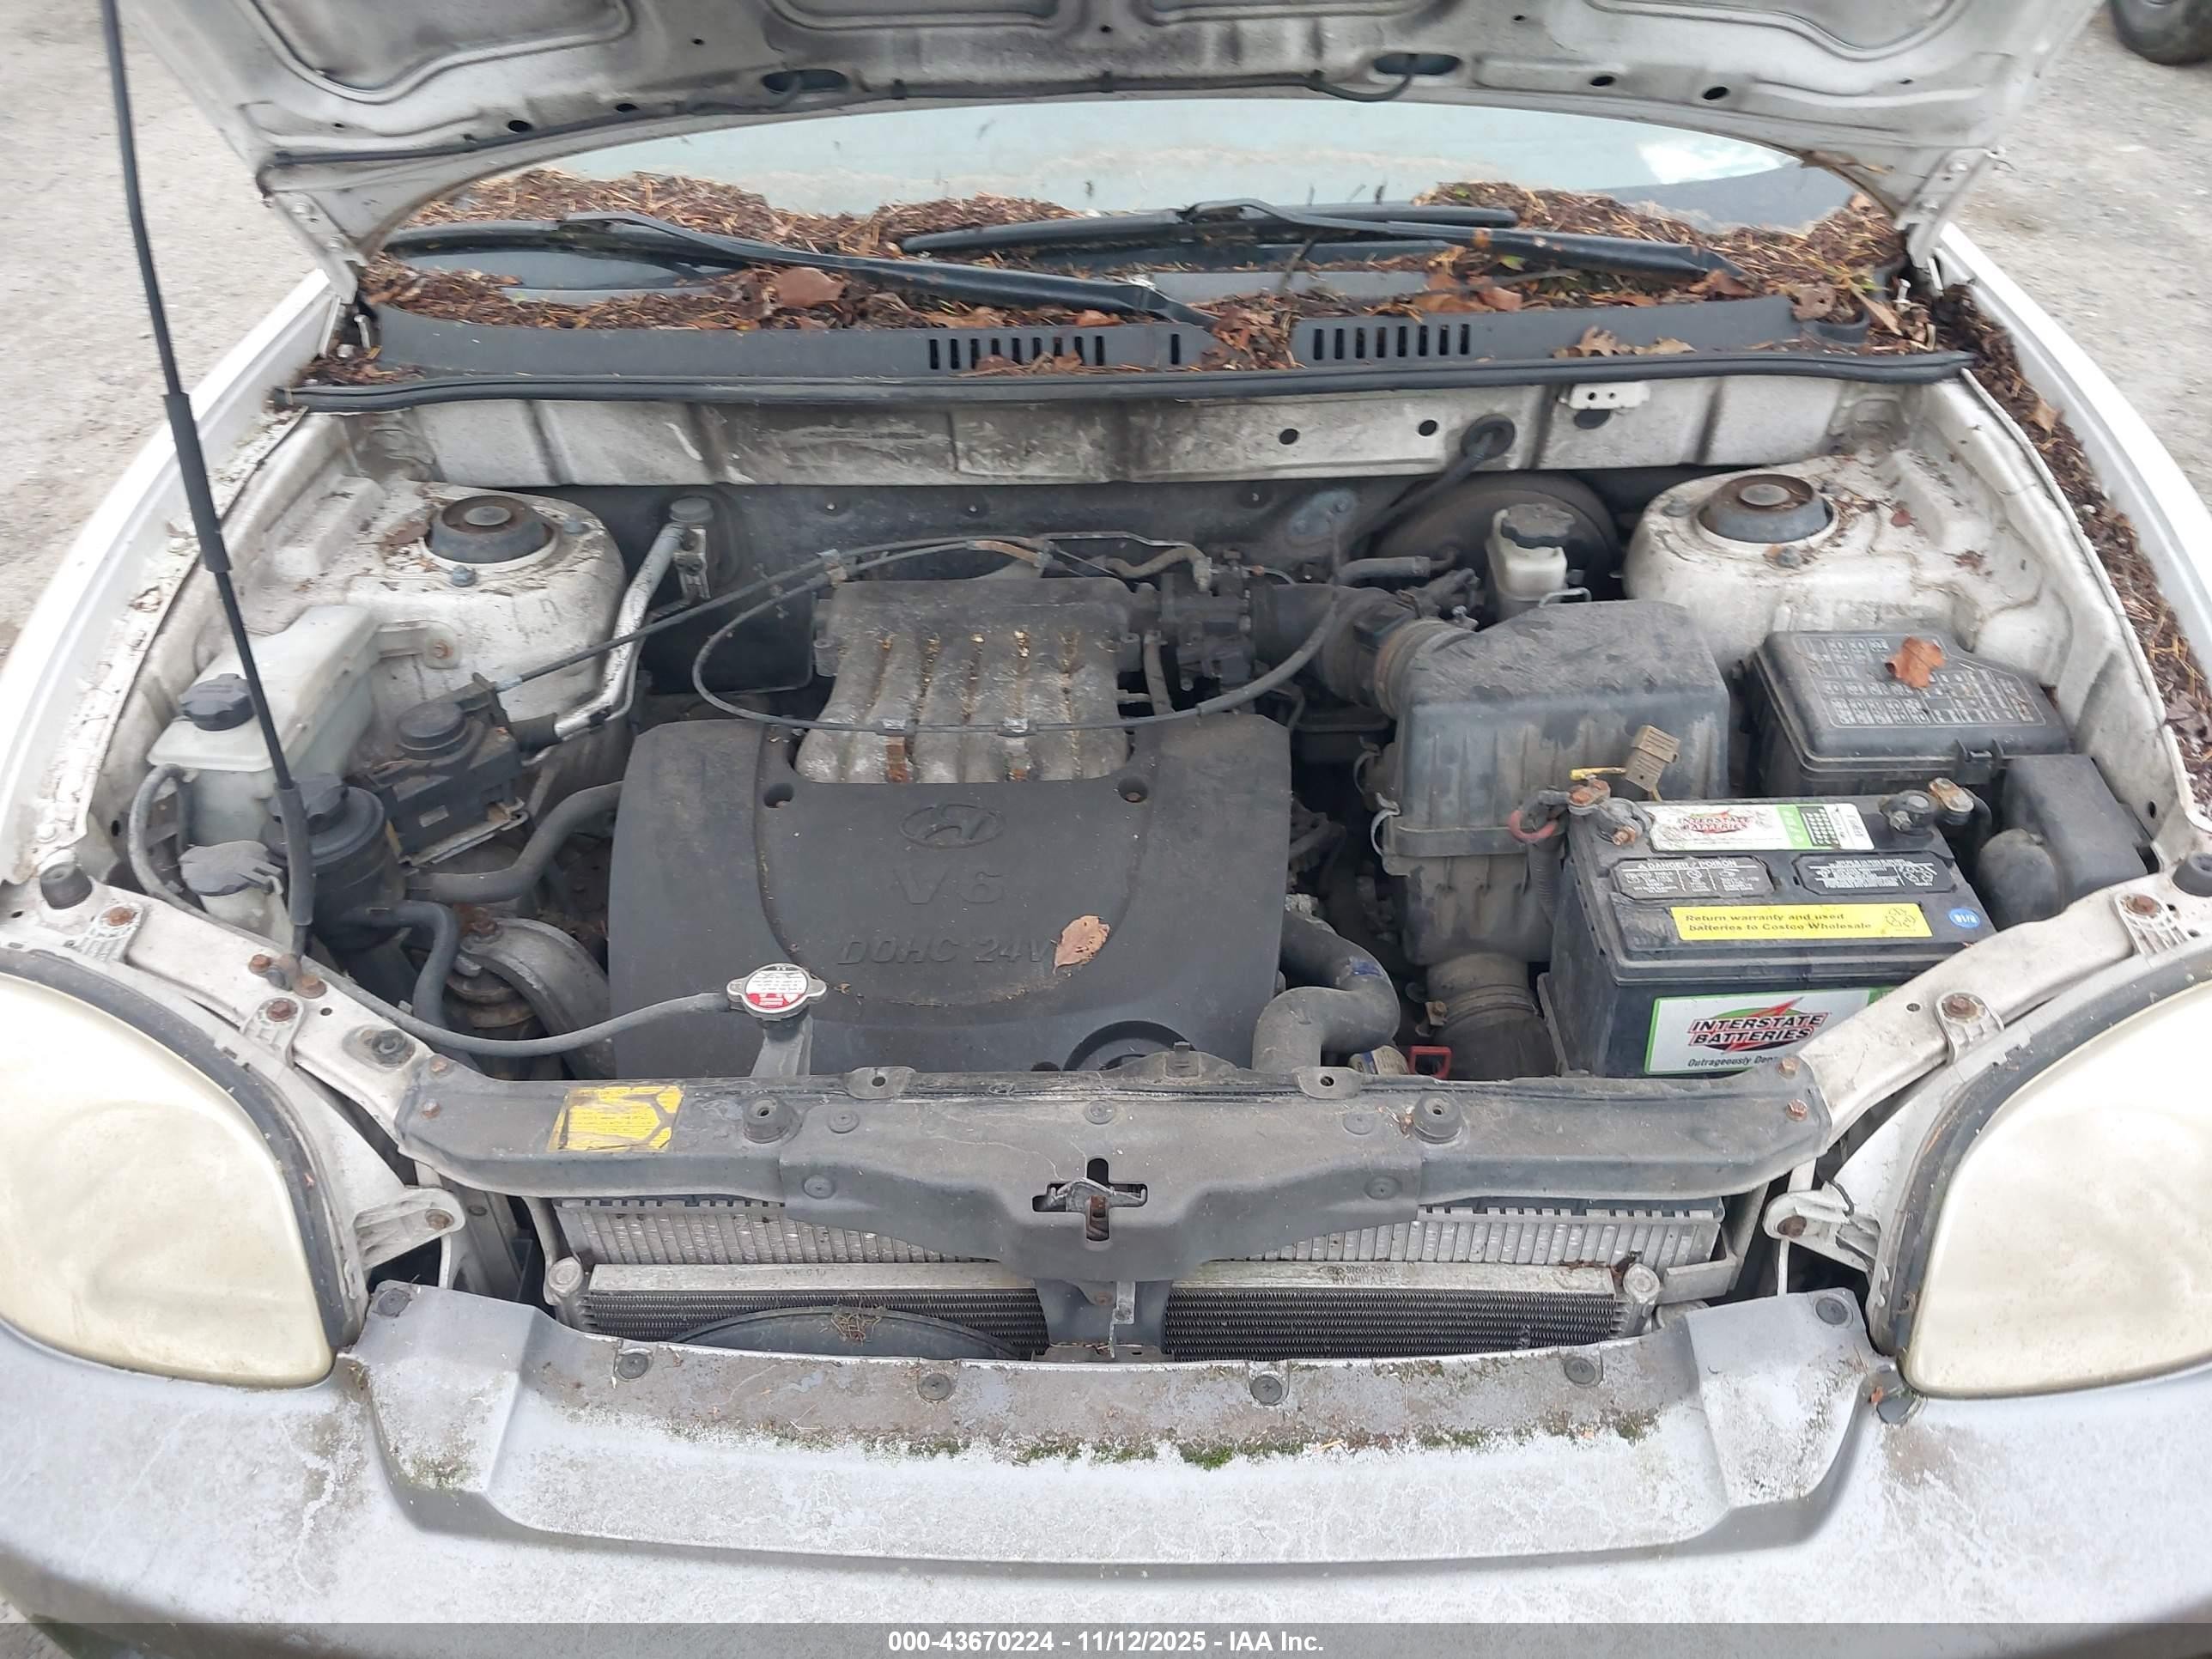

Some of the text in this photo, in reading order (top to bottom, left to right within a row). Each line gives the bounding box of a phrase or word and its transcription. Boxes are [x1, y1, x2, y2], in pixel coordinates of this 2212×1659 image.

[837, 939, 958, 965] DOHC
[1692, 1014, 1824, 1030] INTERSTATE
[1692, 1028, 1812, 1045] BATTERIES
[1687, 1056, 1751, 1067] Outrageously
